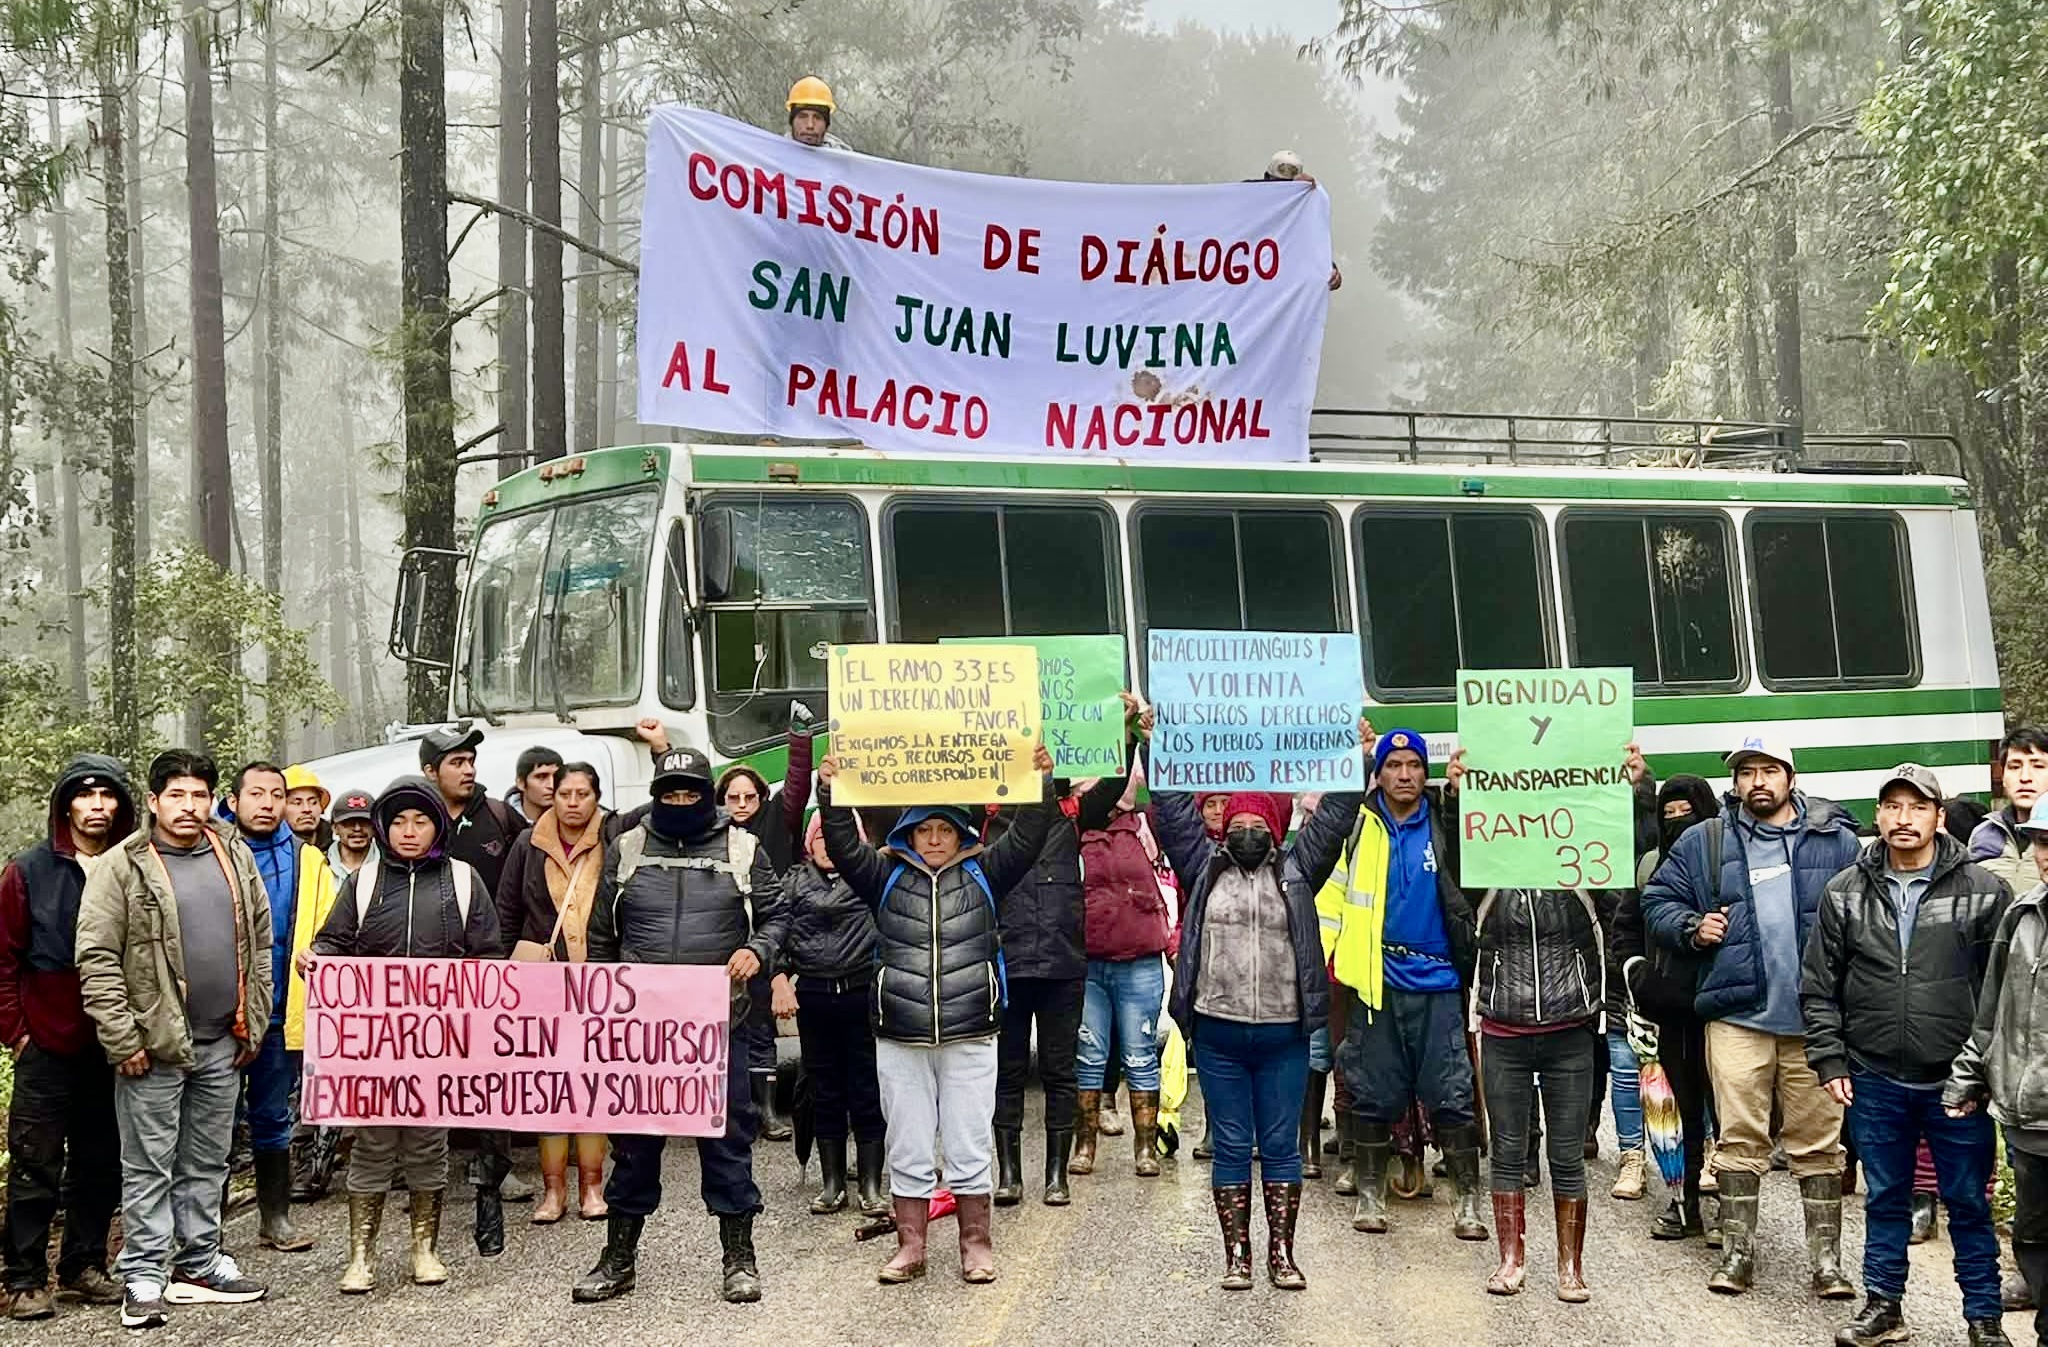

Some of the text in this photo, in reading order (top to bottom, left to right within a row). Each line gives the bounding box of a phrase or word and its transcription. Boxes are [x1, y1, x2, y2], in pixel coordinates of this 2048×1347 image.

[688, 152, 1280, 286] COMISIÓN DE DIÁLOGO
[748, 260, 1238, 370] SAN JUAN LUVINA
[661, 340, 1271, 450] AL PALACIO NACIONAL
[888, 658, 943, 684] RAMO
[953, 659, 982, 683] 33
[987, 661, 1016, 684] ES
[1038, 657, 1075, 676] OMOS
[839, 688, 862, 713] UN
[944, 687, 966, 710] NO
[968, 683, 991, 709] UN
[1041, 678, 1075, 700] NOS
[1187, 671, 1305, 699] VIOLENTA
[1463, 677, 1618, 707] DIGNIDAD
[960, 701, 1032, 737] FAVOR!
[1156, 702, 1353, 727] NUESTROS DERECHOS
[912, 733, 933, 748] LA
[939, 731, 1008, 749] ENTREGA
[1051, 728, 1071, 747] SE
[1162, 729, 1356, 754] LOS PUEBLOS INDIGENAS
[1528, 714, 1553, 746] Y
[838, 748, 1016, 770] DE LOS RECURSOS QUE
[1428, 742, 1451, 756] uan
[860, 762, 1009, 797] NOS CORRESPONDEN!
[1153, 756, 1353, 788] MERECEMOS RESPETO
[1465, 763, 1634, 792] TRANSPARENCIA
[1464, 807, 1574, 842] RAMO
[1555, 840, 1613, 889] 33
[385, 957, 521, 1012] ENGAÑOS
[563, 964, 636, 1015] NOS
[317, 1011, 728, 1072] DEJARON SIN RECURSO!
[302, 1061, 727, 1129] ¡EXIGIMOS RESPUESTA Y SOLUCIÓN!
